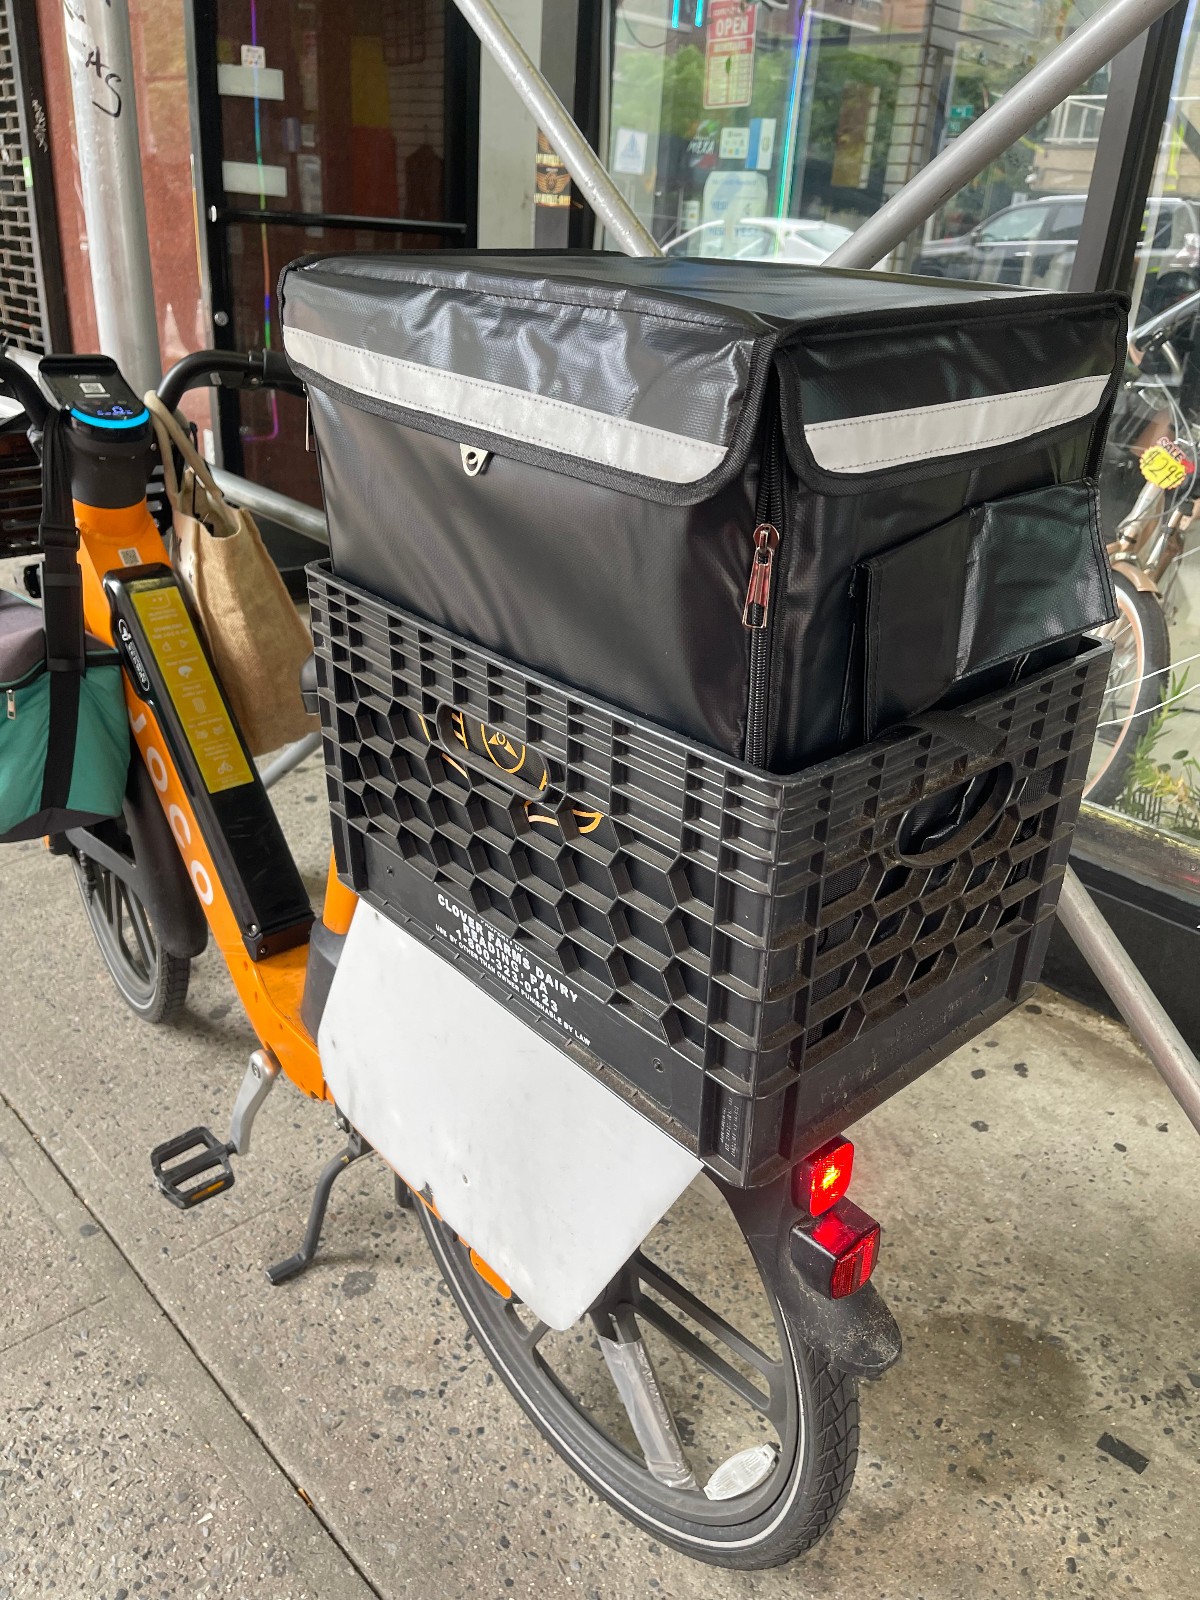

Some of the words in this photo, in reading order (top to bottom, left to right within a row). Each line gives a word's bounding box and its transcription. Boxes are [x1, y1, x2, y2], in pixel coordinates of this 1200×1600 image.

[715, 14, 749, 37] OPEN
[435, 923, 447, 937] USE
[449, 934, 457, 944] BY
[458, 942, 479, 961] OTHER
[480, 959, 496, 974] THAN
[497, 971, 520, 992] OWNER
[520, 988, 562, 1025] PUNISHABLE
[563, 1020, 573, 1032] BY
[574, 1029, 591, 1046] LAW
[437, 893, 484, 936] CLOVER
[487, 930, 531, 970] FARMS
[535, 965, 578, 1003] DAIRY
[455, 929, 558, 1013] 1-800-323-0123
[529, 973, 548, 995] PA
